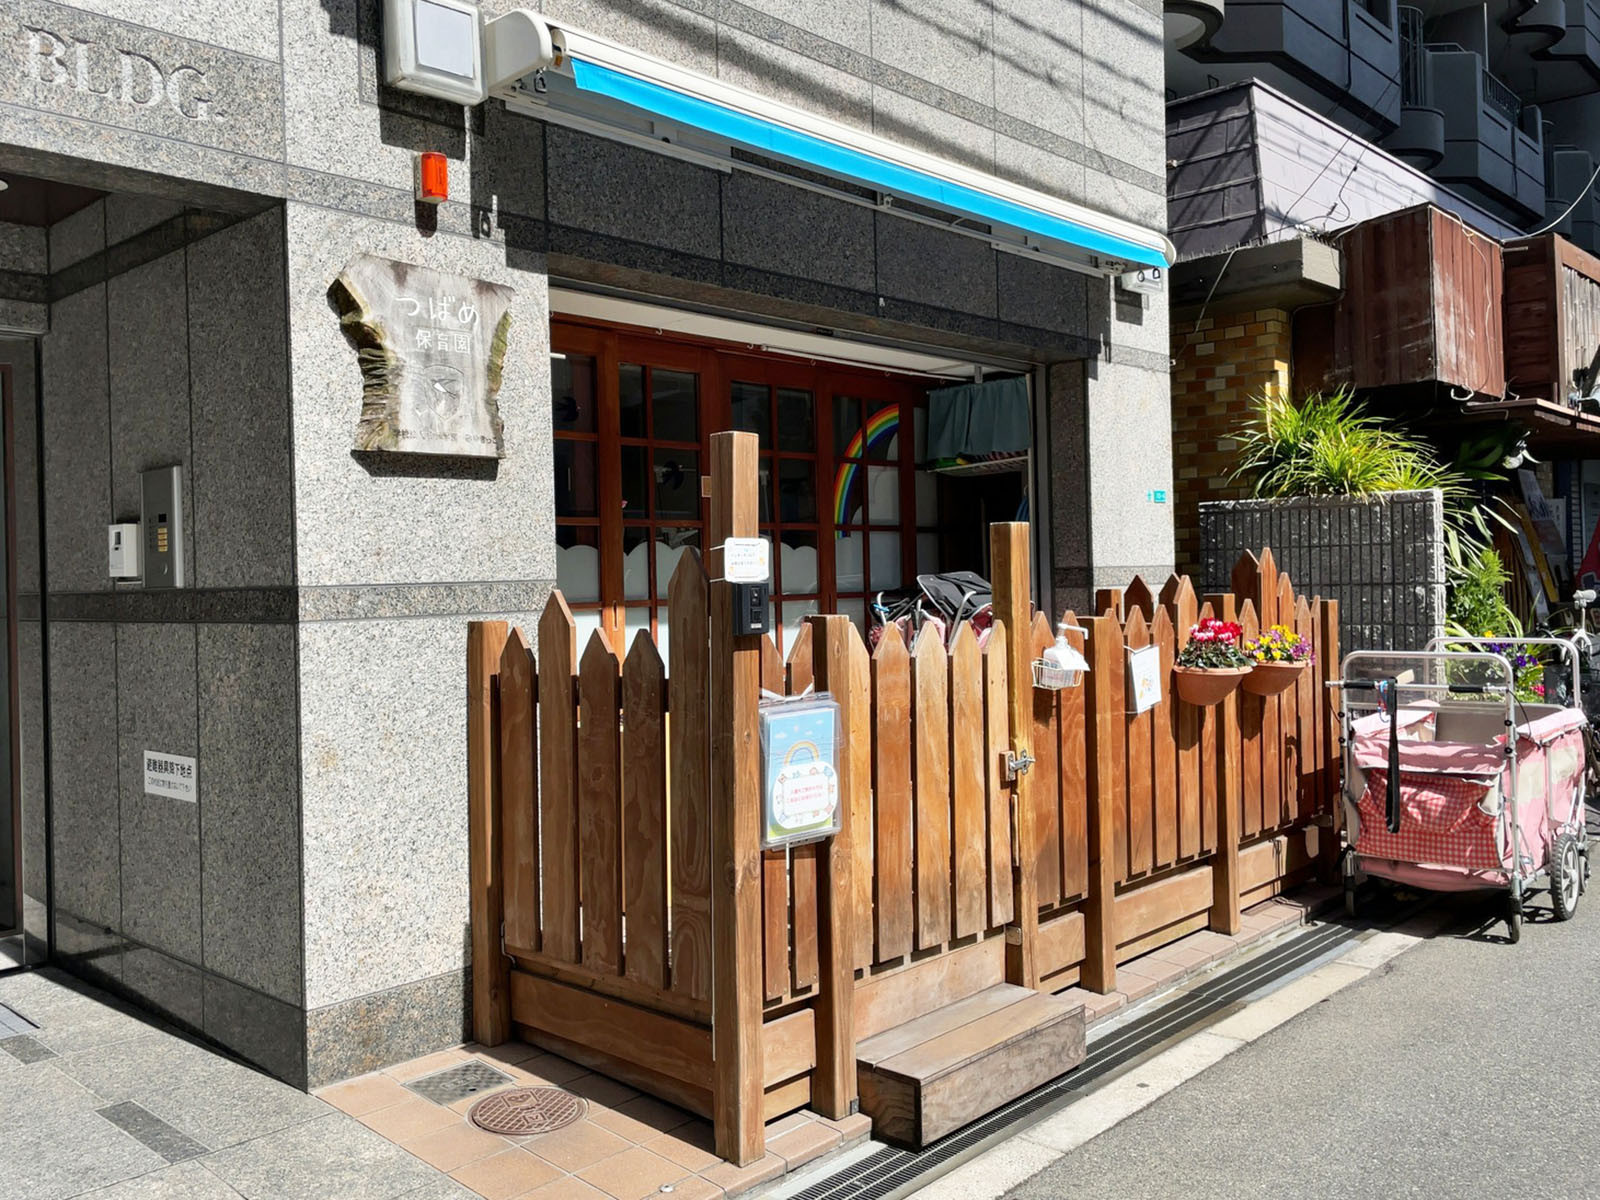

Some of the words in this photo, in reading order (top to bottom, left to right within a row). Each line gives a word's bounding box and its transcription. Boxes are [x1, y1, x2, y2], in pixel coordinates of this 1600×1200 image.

[395, 295, 480, 326] つばめ
[415, 328, 471, 355] 保育園
